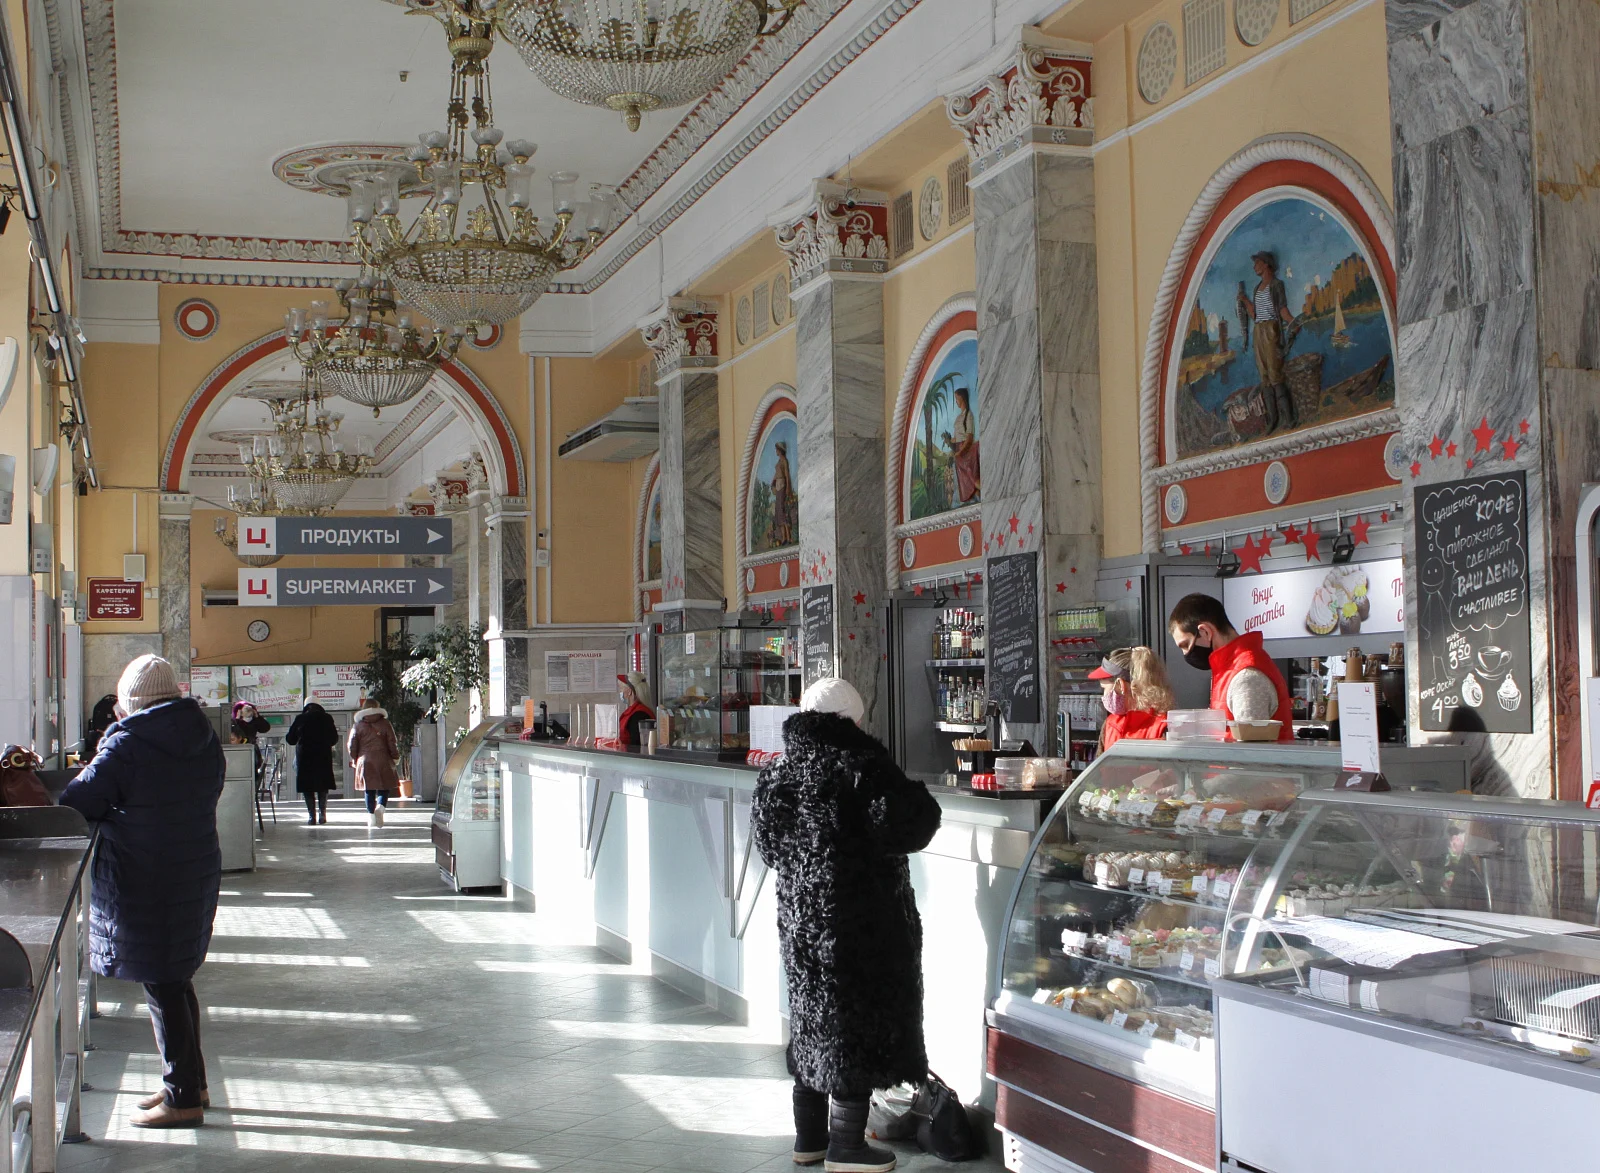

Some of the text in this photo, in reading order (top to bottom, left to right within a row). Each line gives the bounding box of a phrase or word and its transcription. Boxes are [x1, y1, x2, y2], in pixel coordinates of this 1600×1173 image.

[1476, 494, 1515, 522] КОФЕ
[301, 529, 400, 546] ПРОДУКТЫ
[1446, 523, 1504, 557] ПИРОЖНОЕ
[1454, 525, 1461, 538] И
[1465, 537, 1512, 569] СДЕЛАЮТ
[285, 579, 417, 595] SUPERMARKET
[1457, 558, 1519, 598] ВАШ ДЕНЬ
[1252, 585, 1274, 606] Вкус
[1458, 588, 1518, 618] СЧАСТЛИВЕЕ
[1244, 602, 1285, 632] детства
[1448, 637, 1466, 651] ЛАТТЕ
[1435, 677, 1456, 694] ОСКАР
